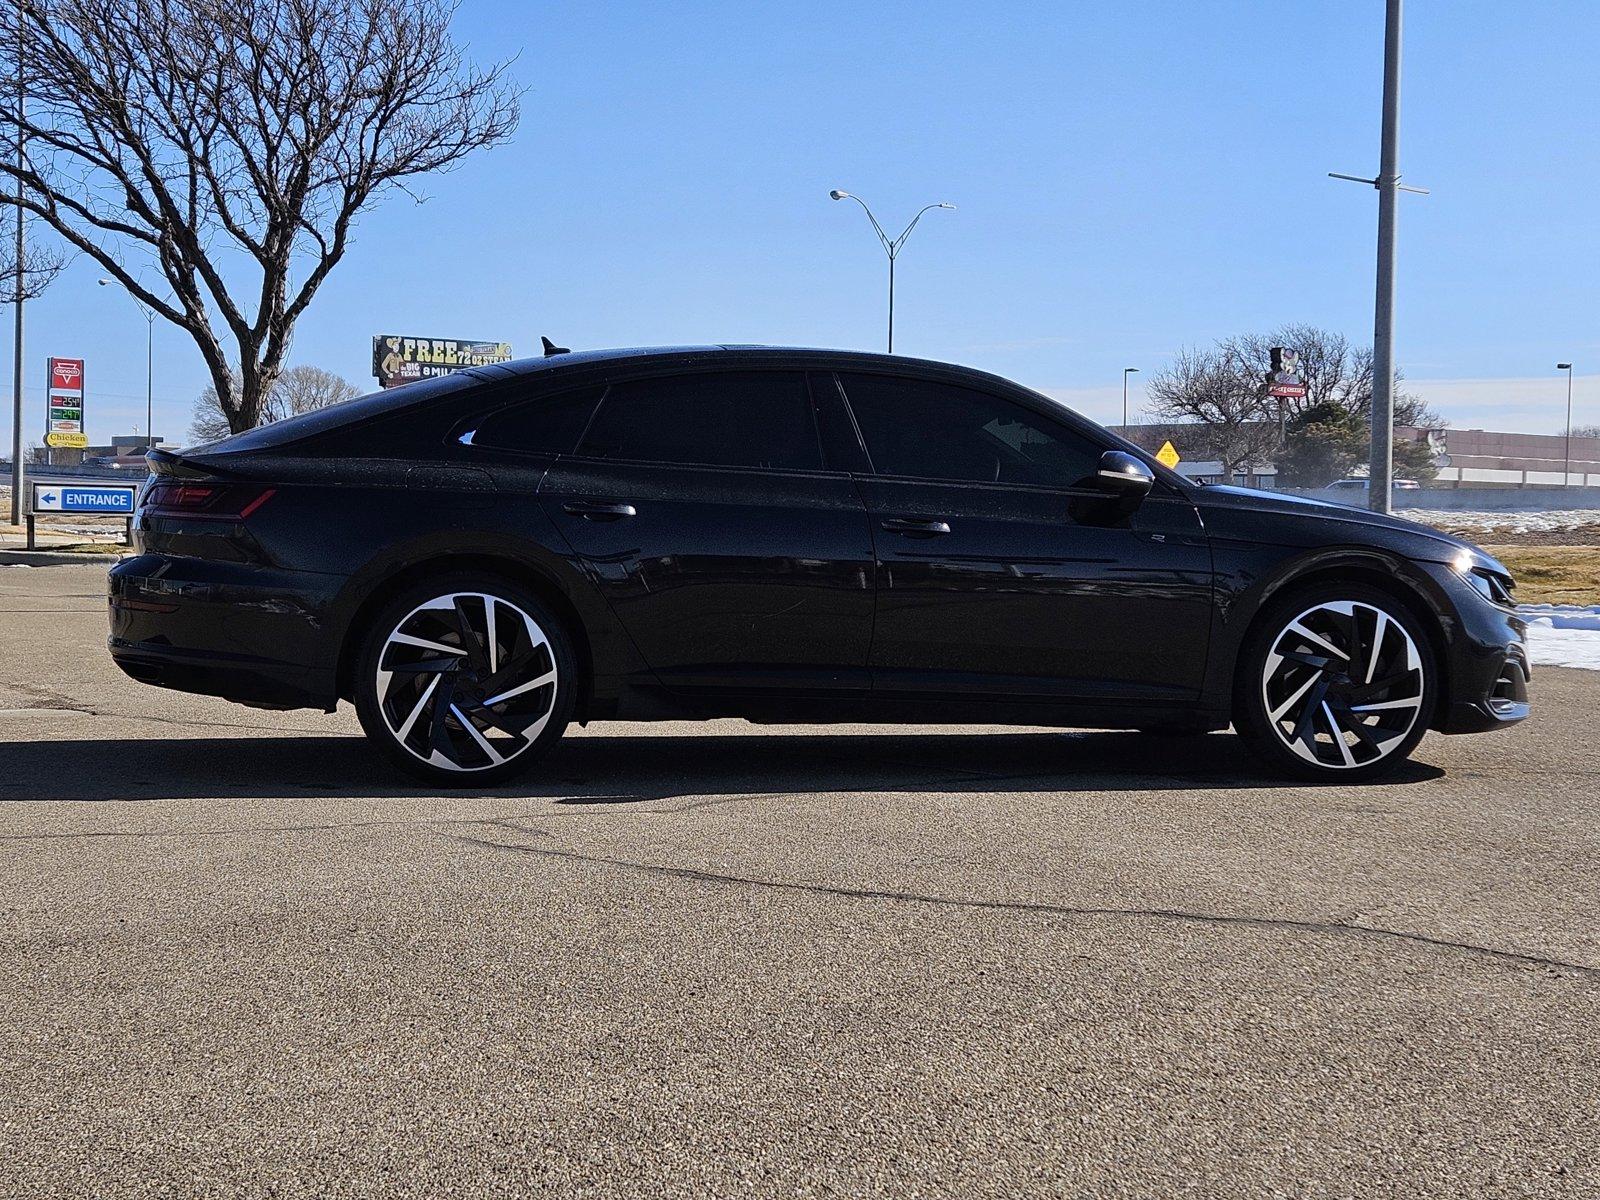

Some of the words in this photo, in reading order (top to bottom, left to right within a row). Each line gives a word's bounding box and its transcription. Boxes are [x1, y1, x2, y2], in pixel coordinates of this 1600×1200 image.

[403, 339, 457, 363] FREE
[457, 350, 471, 364] 72
[406, 362, 420, 371] BIG
[423, 367, 430, 375] 8
[50, 433, 86, 442] Chicken
[66, 493, 128, 506] ENTRANCE
